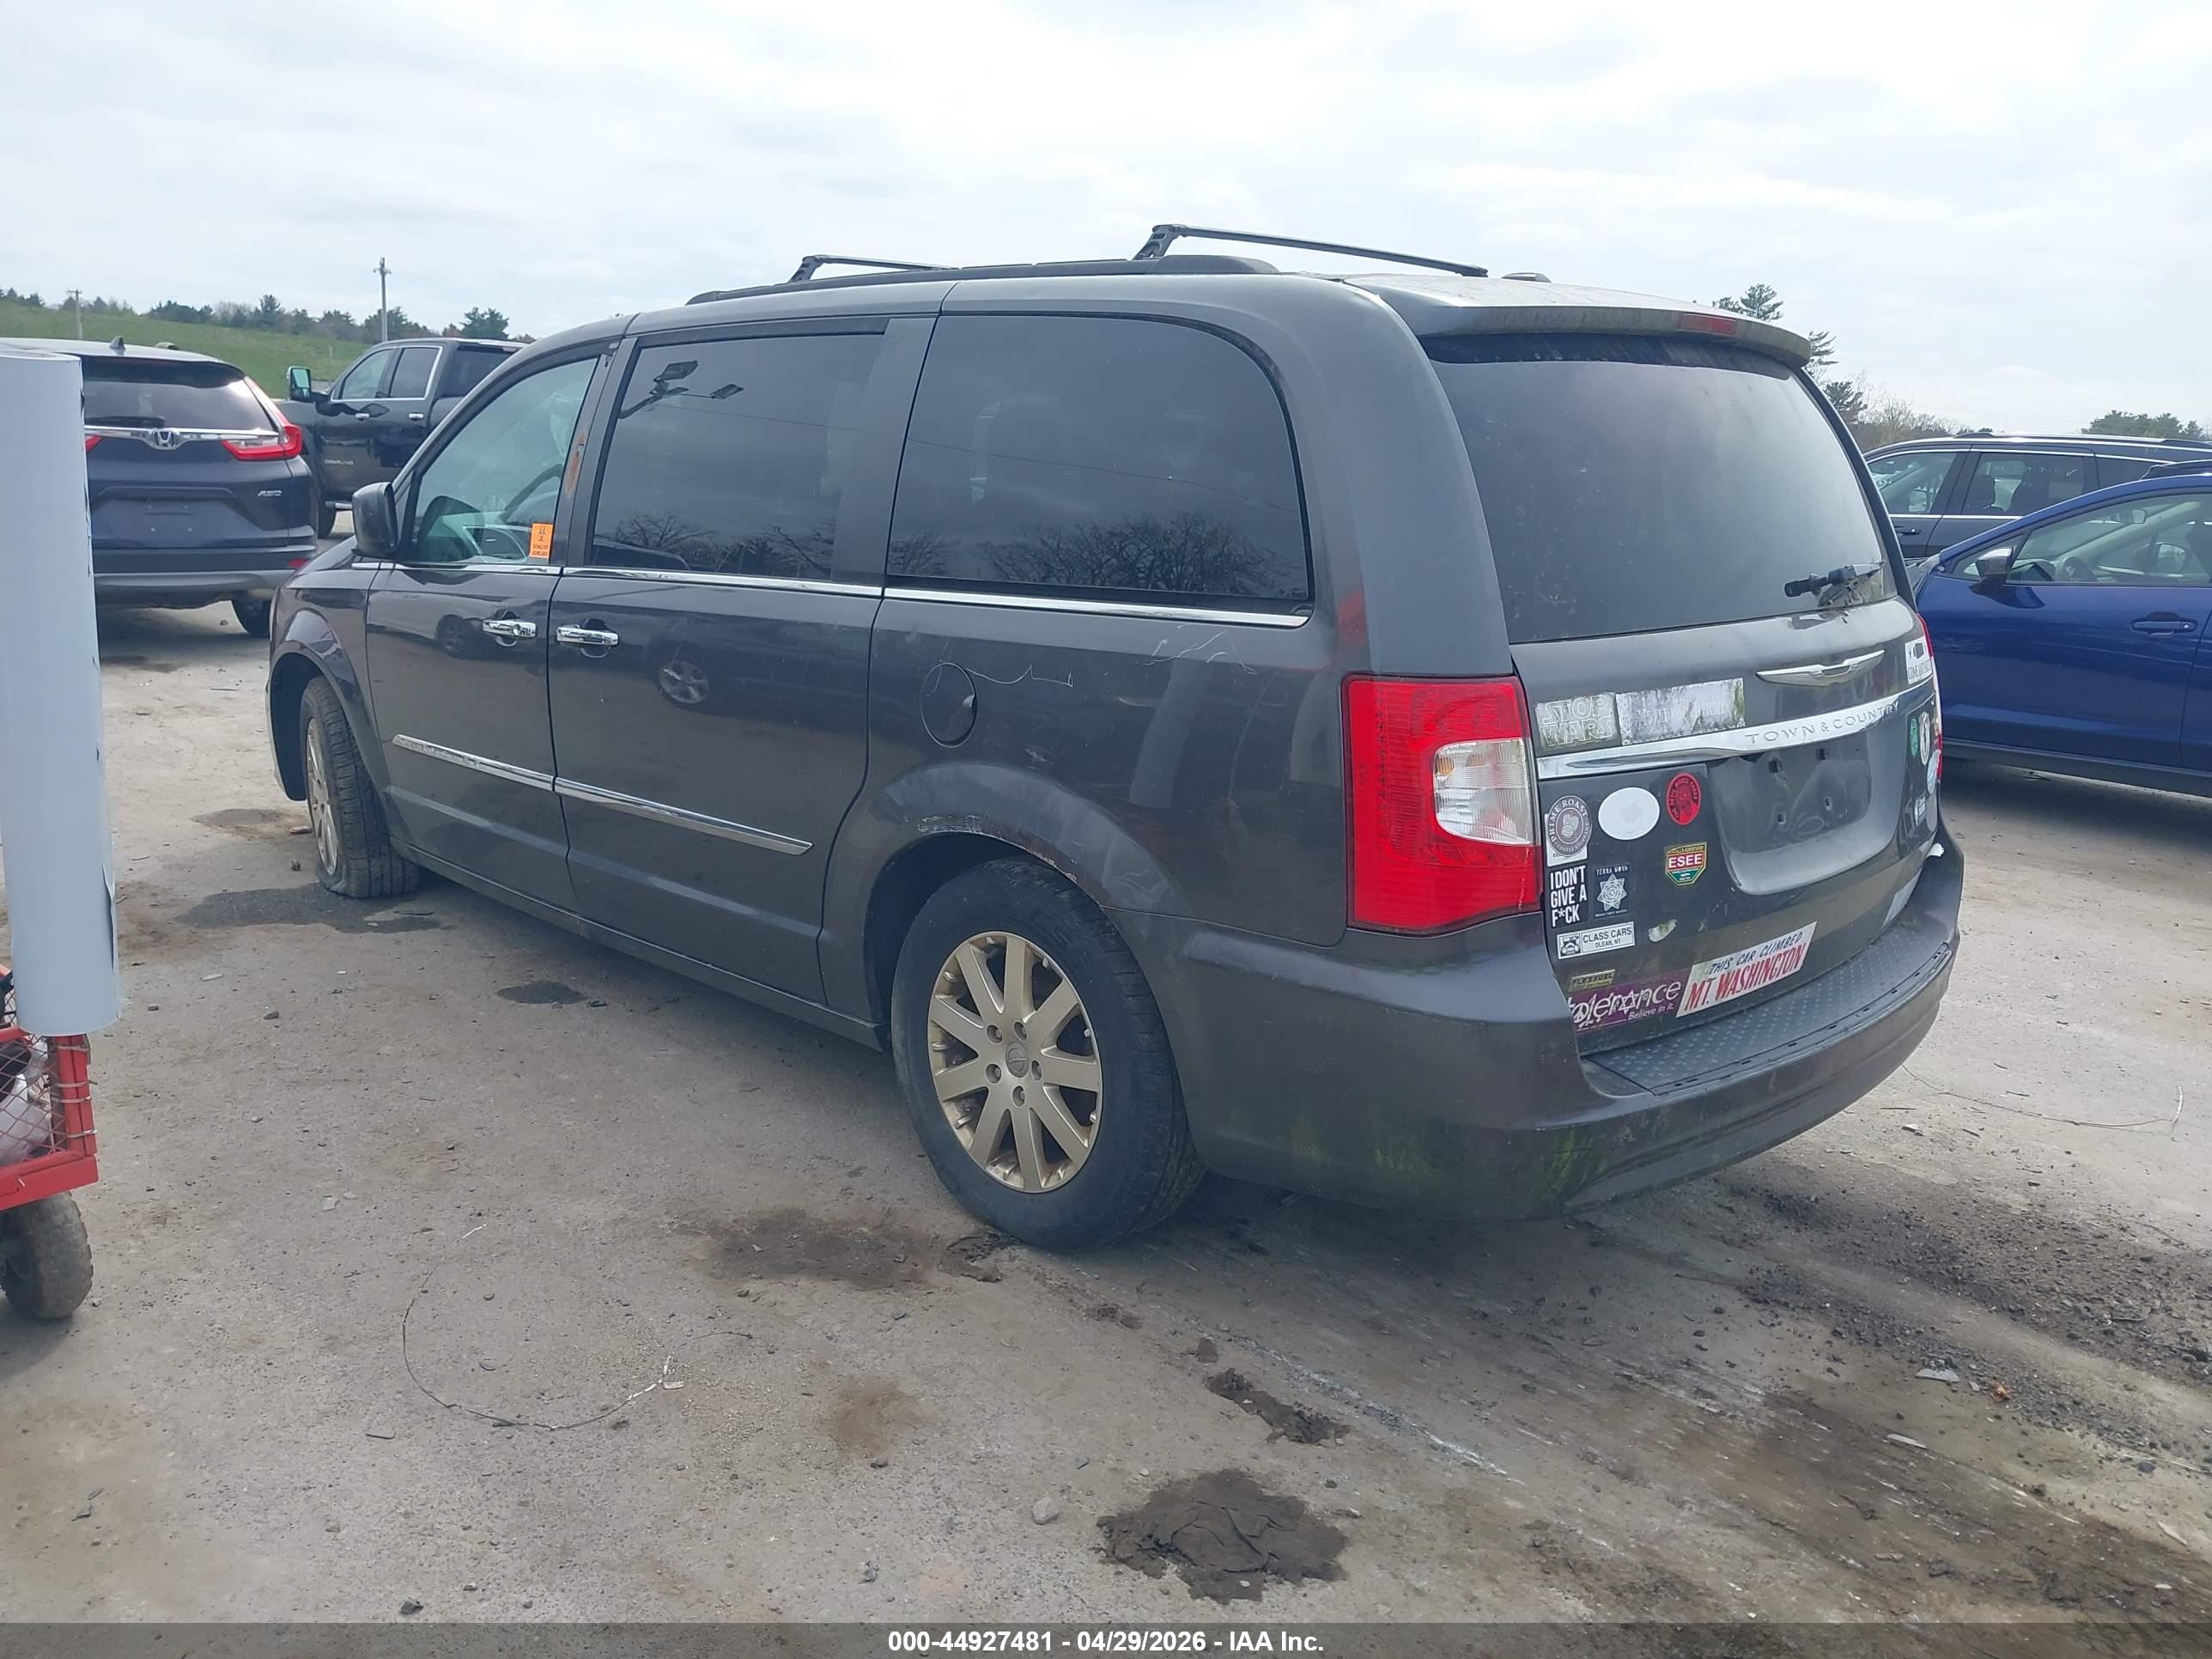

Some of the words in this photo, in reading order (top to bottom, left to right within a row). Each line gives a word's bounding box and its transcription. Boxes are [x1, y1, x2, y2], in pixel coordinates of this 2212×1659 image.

[1542, 694, 1609, 726] STOP
[1540, 715, 1613, 747] WARS
[1549, 805, 1561, 843] PRIME
[1561, 799, 1589, 817] ROAST
[1668, 854, 1702, 868] ESEE
[1550, 872, 1554, 890] I
[1554, 866, 1586, 890] DON'T
[1551, 886, 1576, 908] GIVE
[1579, 884, 1588, 902] A
[1583, 931, 1609, 943] CLASS
[1610, 927, 1632, 939] CARS
[1710, 957, 1734, 975] THIS
[1736, 950, 1757, 966] CAR
[1759, 932, 1802, 958] CLIMBED
[1685, 976, 1717, 1012] MT.
[1715, 942, 1807, 1001] WASHINGTON
[1627, 1008, 1656, 1021] Believe
[1657, 1004, 1666, 1013] in
